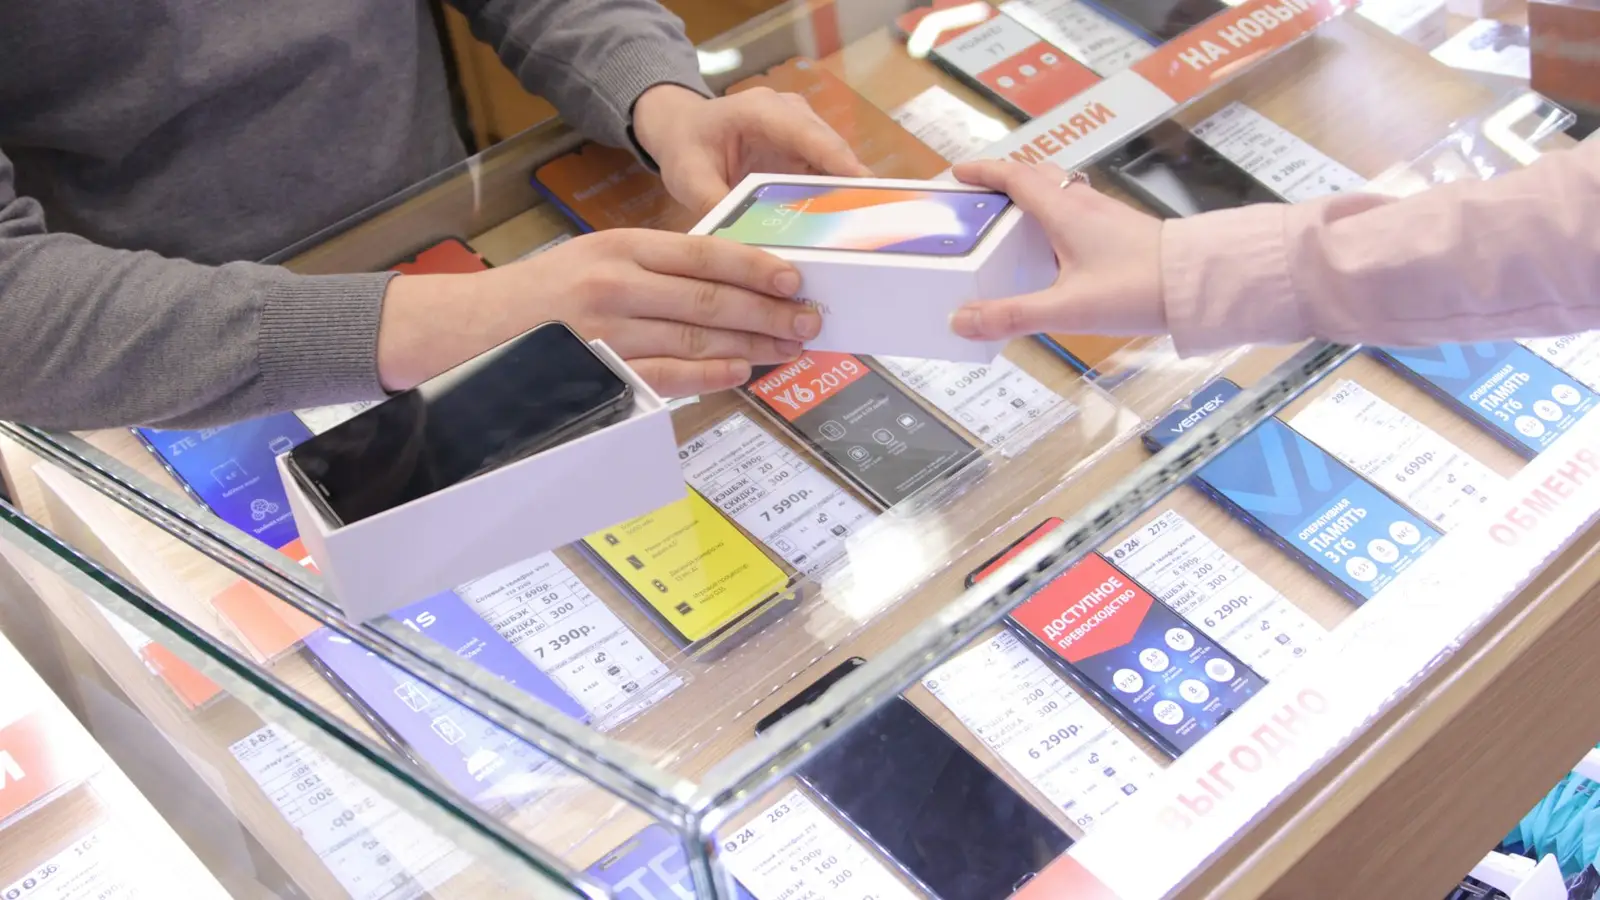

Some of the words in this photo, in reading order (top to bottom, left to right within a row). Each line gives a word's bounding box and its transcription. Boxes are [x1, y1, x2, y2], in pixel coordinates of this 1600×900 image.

[1178, 40, 1230, 71] НА
[1007, 101, 1118, 167] МЕНЯЙ
[758, 356, 814, 396] HUAWEI
[771, 384, 815, 412] Y6
[816, 359, 861, 396] 2019
[945, 384, 956, 397] 8
[1479, 371, 1531, 412] ПАМЯТЬ
[1171, 394, 1226, 434] VERTEX
[1495, 409, 1510, 422] 3
[168, 436, 198, 457] ZTE
[713, 477, 749, 504] КЭШБЭК
[758, 463, 774, 476] 20
[723, 486, 759, 511] СКИДКА
[768, 470, 790, 487] 300
[1394, 472, 1406, 483] 6
[759, 510, 772, 523] 7
[772, 486, 815, 516] 590р.
[1298, 497, 1352, 542] ОПЕРАТИВНАЯ
[1125, 539, 1139, 552] 24
[1147, 519, 1169, 537] 275
[1307, 506, 1368, 553] ПАМЯТЬ
[1325, 549, 1341, 564] 3
[1336, 535, 1357, 555] Гб
[1193, 562, 1214, 580] 200
[516, 595, 524, 604] 7
[523, 581, 553, 602] 690р.
[1042, 575, 1124, 641] ДОСТУПНОЕ
[1170, 589, 1197, 611] КИДКА
[1206, 573, 1228, 591] 300
[402, 610, 437, 633] 1s
[495, 607, 530, 632] ЭШБЭК
[541, 591, 560, 606] 50
[502, 617, 538, 641] КИДКА
[548, 602, 575, 620] 300
[1057, 588, 1137, 650] ПРЕВОСХОДСТВО
[1203, 616, 1216, 629] 6
[1214, 593, 1253, 621] 290р.
[533, 647, 547, 661] 7
[547, 623, 598, 653] 390р.
[1171, 632, 1185, 644] 16
[1023, 688, 1045, 706] 200
[1037, 700, 1059, 718] 300
[1028, 747, 1041, 760] 6
[1039, 722, 1084, 752] 290р.
[736, 828, 755, 845] 24
[766, 803, 791, 825] 263
[789, 864, 799, 874] 6
[813, 855, 840, 875] 160
[827, 867, 854, 890] 300
